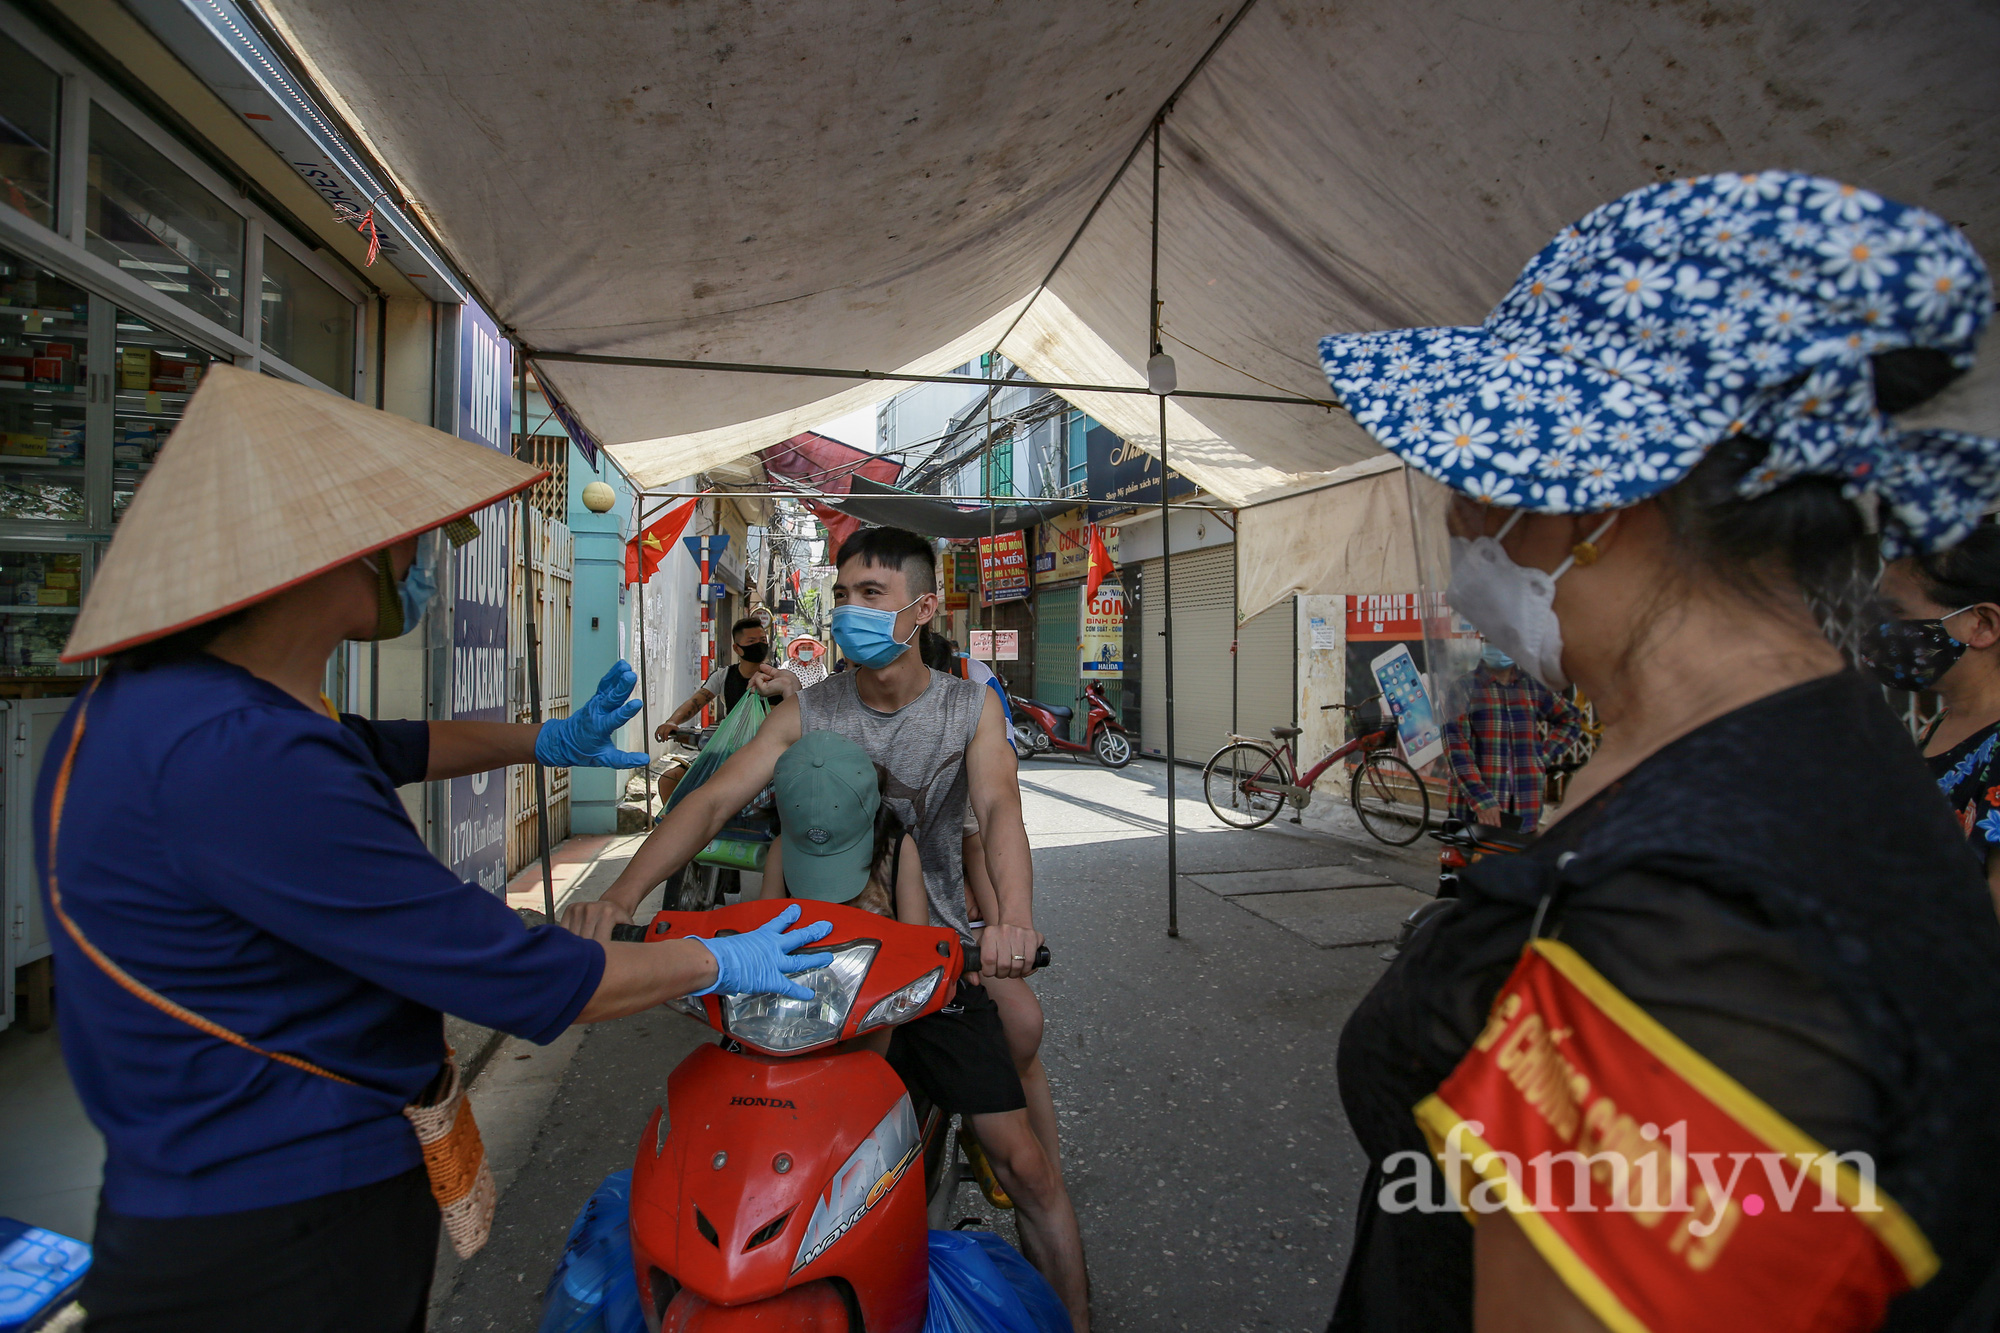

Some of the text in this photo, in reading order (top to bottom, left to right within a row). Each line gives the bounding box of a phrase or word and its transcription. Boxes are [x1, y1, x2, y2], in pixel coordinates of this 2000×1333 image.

[1105, 491, 1117, 501] Shop
[453, 818, 472, 866] 170
[729, 1095, 797, 1110] HONDA
